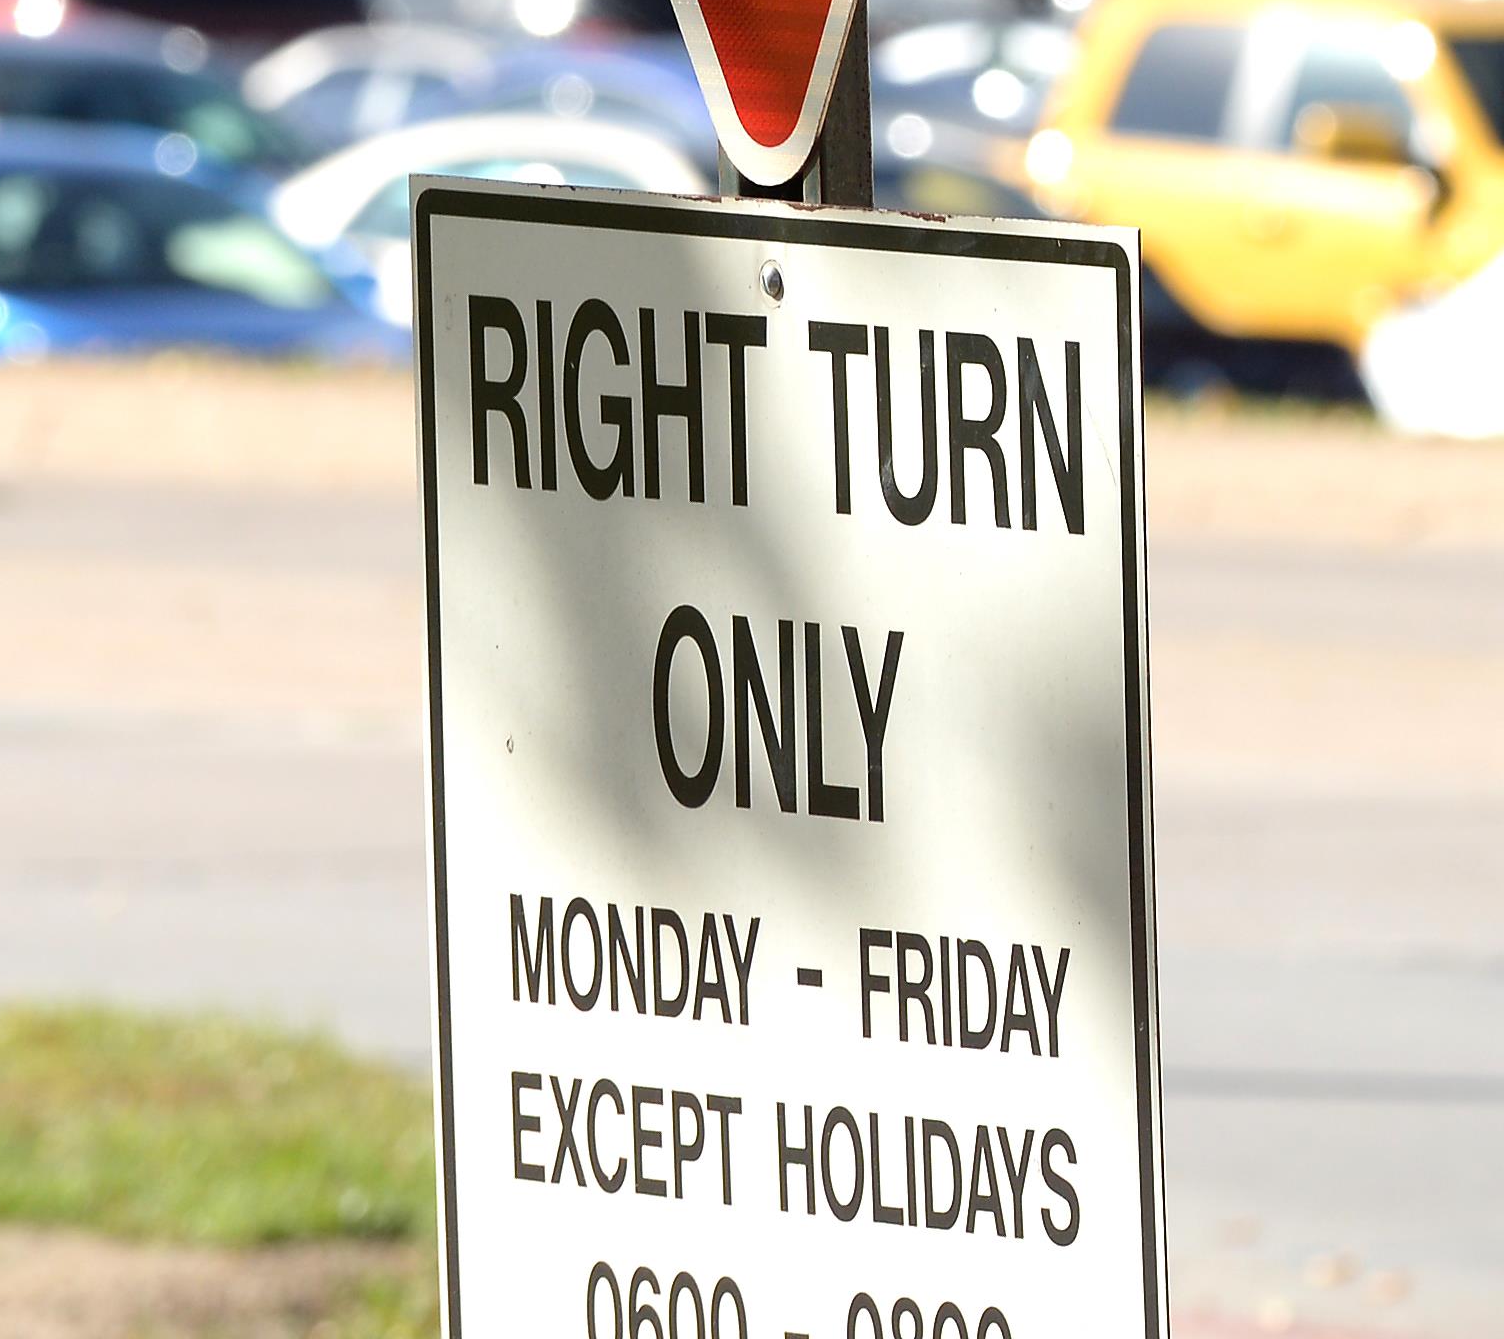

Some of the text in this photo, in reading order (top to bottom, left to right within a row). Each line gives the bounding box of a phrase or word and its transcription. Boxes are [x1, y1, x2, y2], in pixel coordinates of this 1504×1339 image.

[466, 293, 1087, 537] RIGHT TURN
[651, 603, 905, 824] ONLY
[508, 892, 762, 1027] MONDAY
[858, 926, 1072, 1059] FRIDAY
[510, 1070, 1081, 1248] EXCEPT HOLIDAYS
